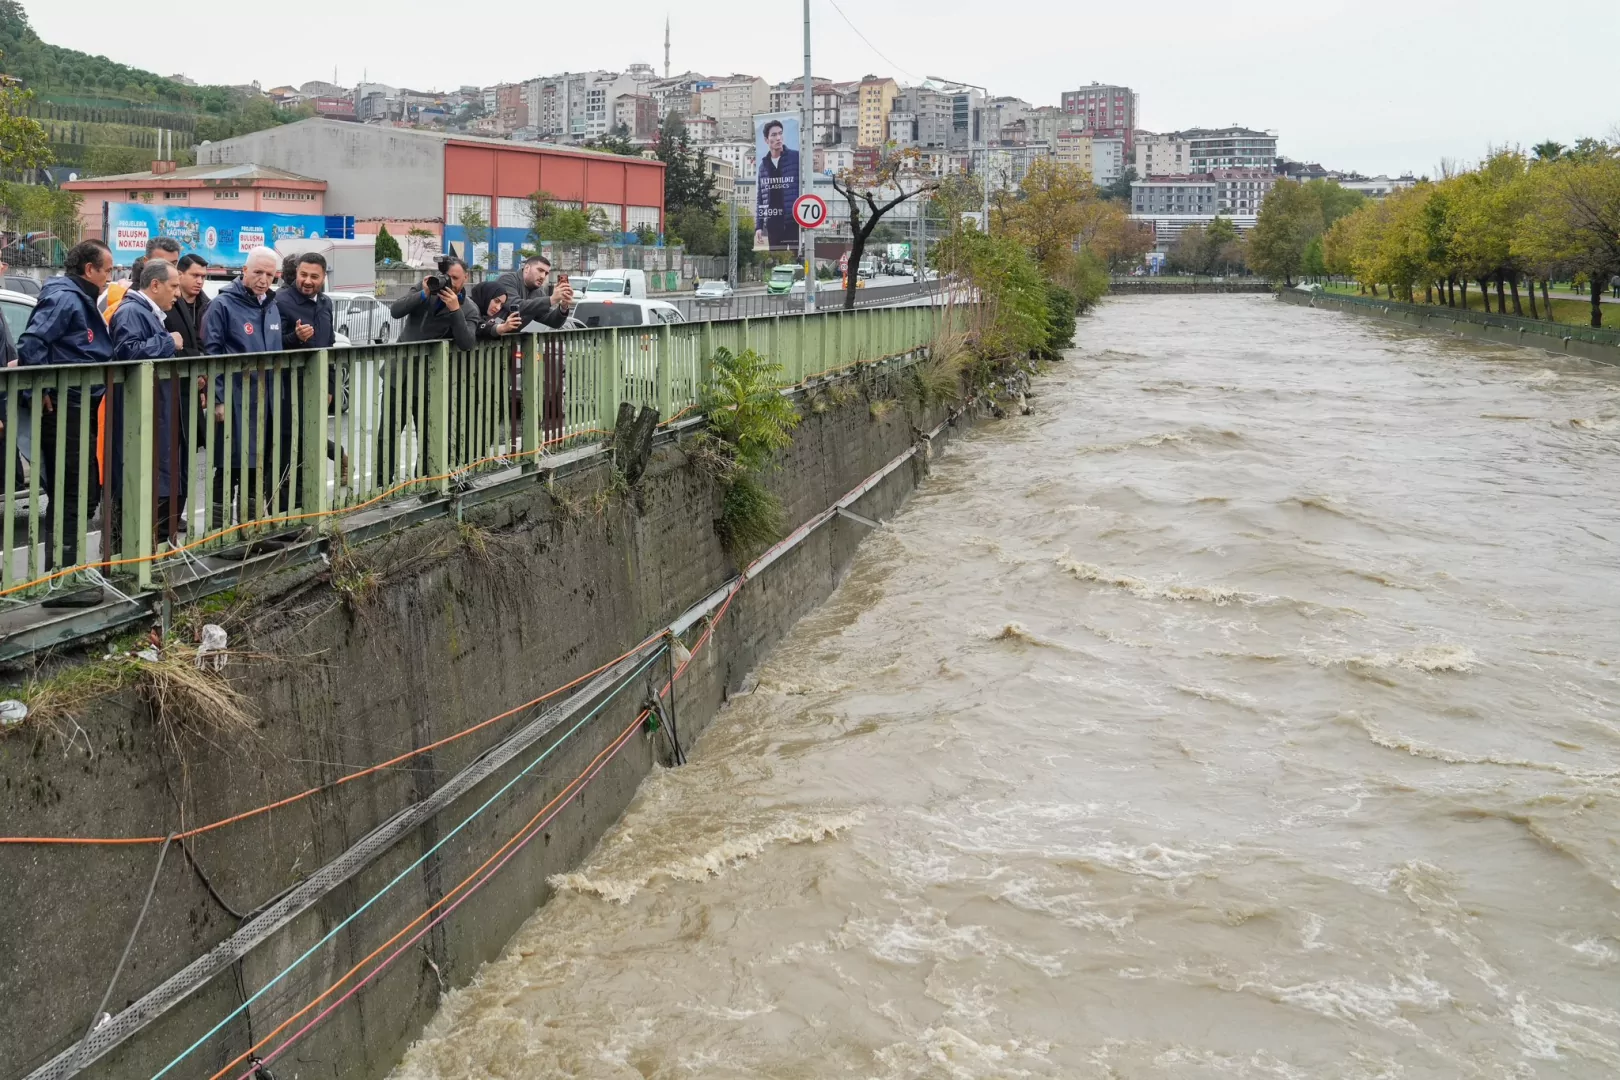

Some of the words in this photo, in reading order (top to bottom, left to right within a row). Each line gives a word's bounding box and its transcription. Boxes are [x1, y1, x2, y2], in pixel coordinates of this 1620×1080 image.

[801, 204, 820, 220] 70
[118, 230, 148, 239] BULUŞMA
[118, 240, 146, 248] NOKTASI
